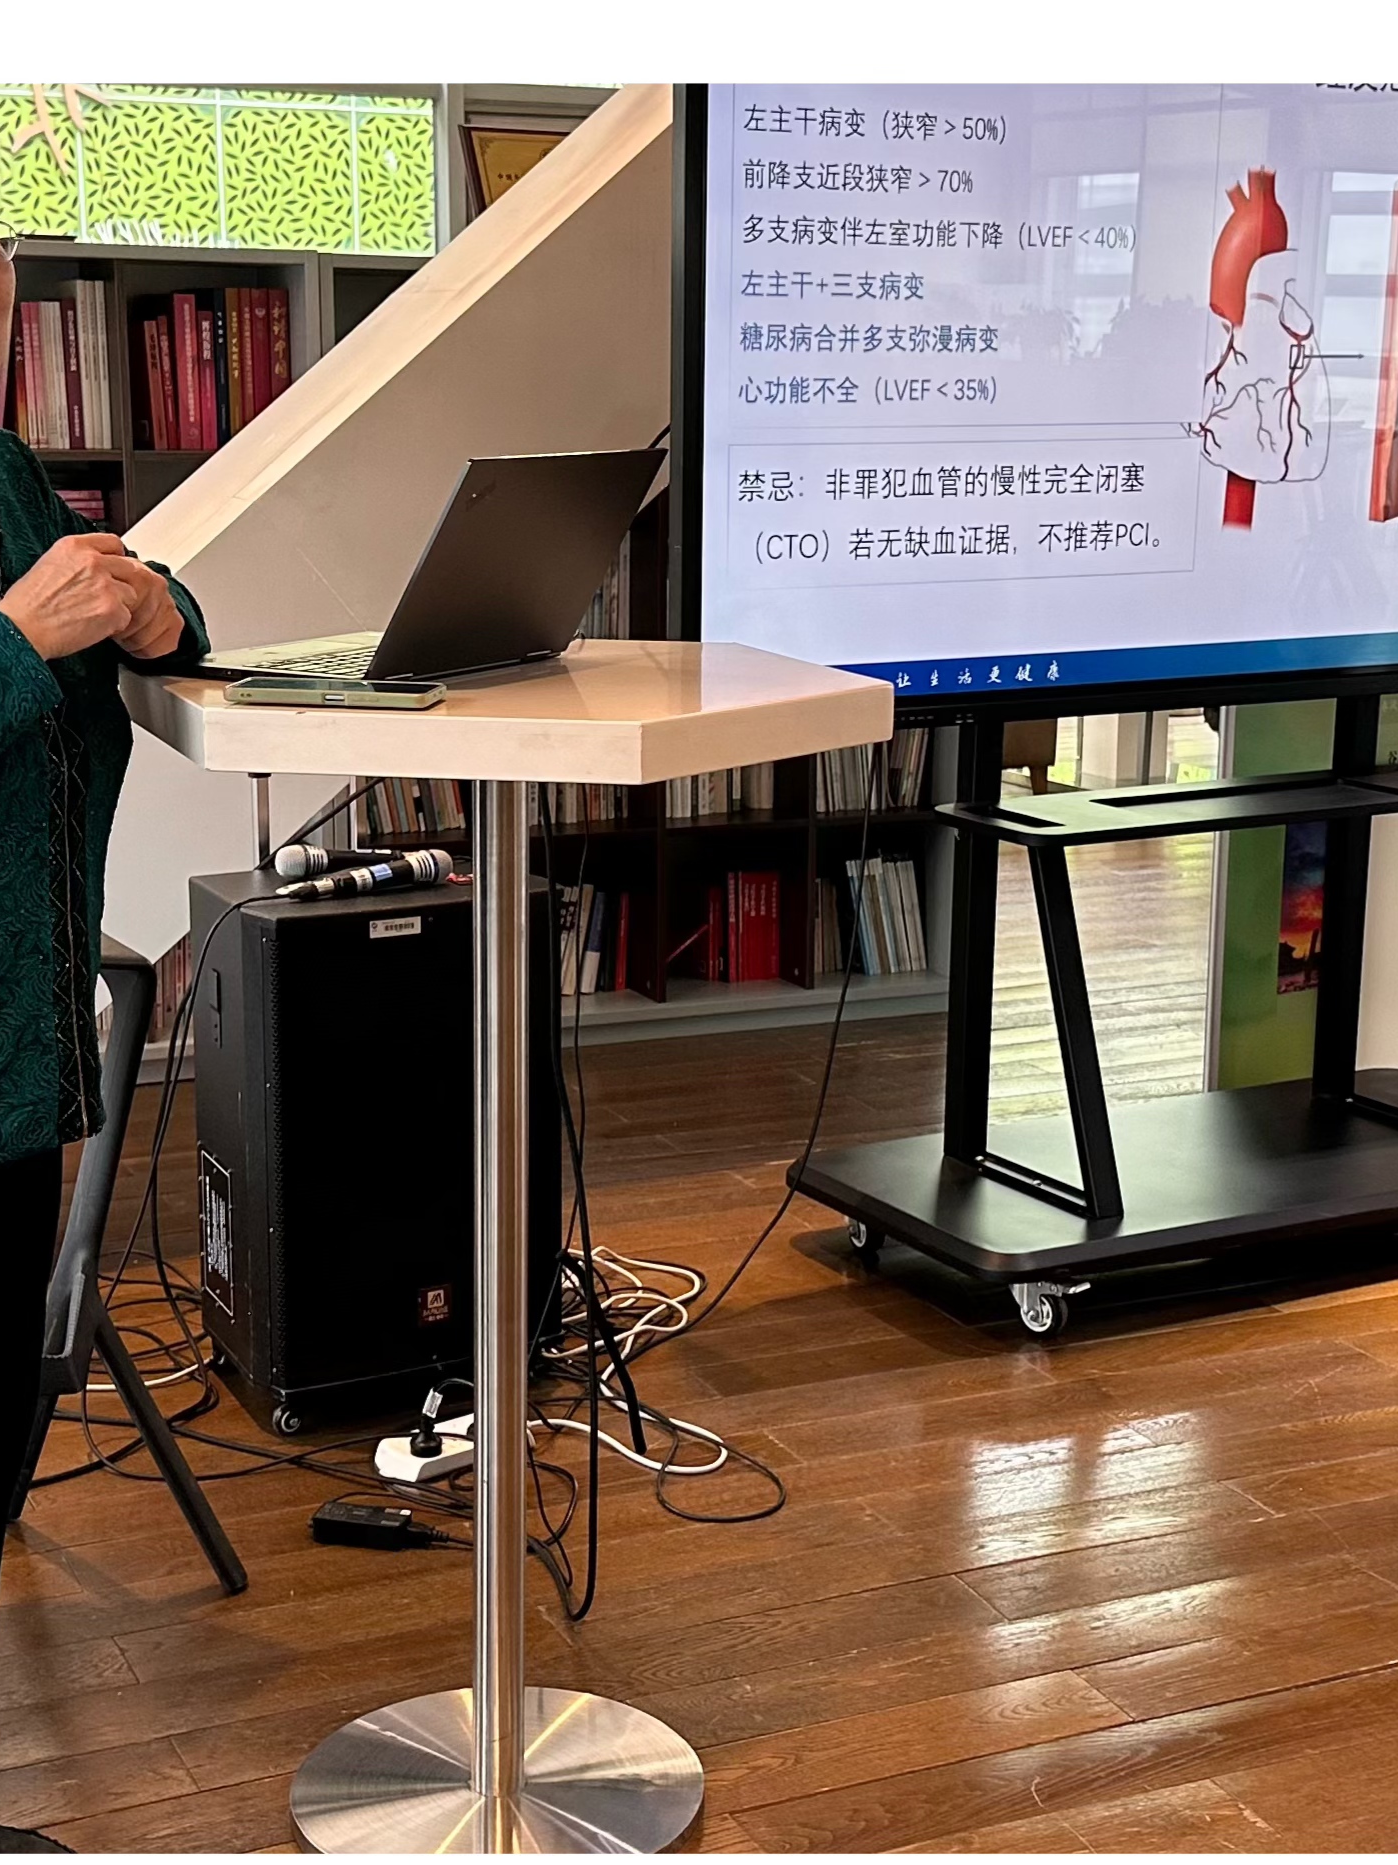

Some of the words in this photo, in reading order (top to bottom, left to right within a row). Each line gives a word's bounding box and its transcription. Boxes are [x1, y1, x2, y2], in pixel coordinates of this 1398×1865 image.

[741, 269, 925, 300] 左主干+三支病变
[740, 322, 999, 353] 糖尿病合并多支弥漫病变
